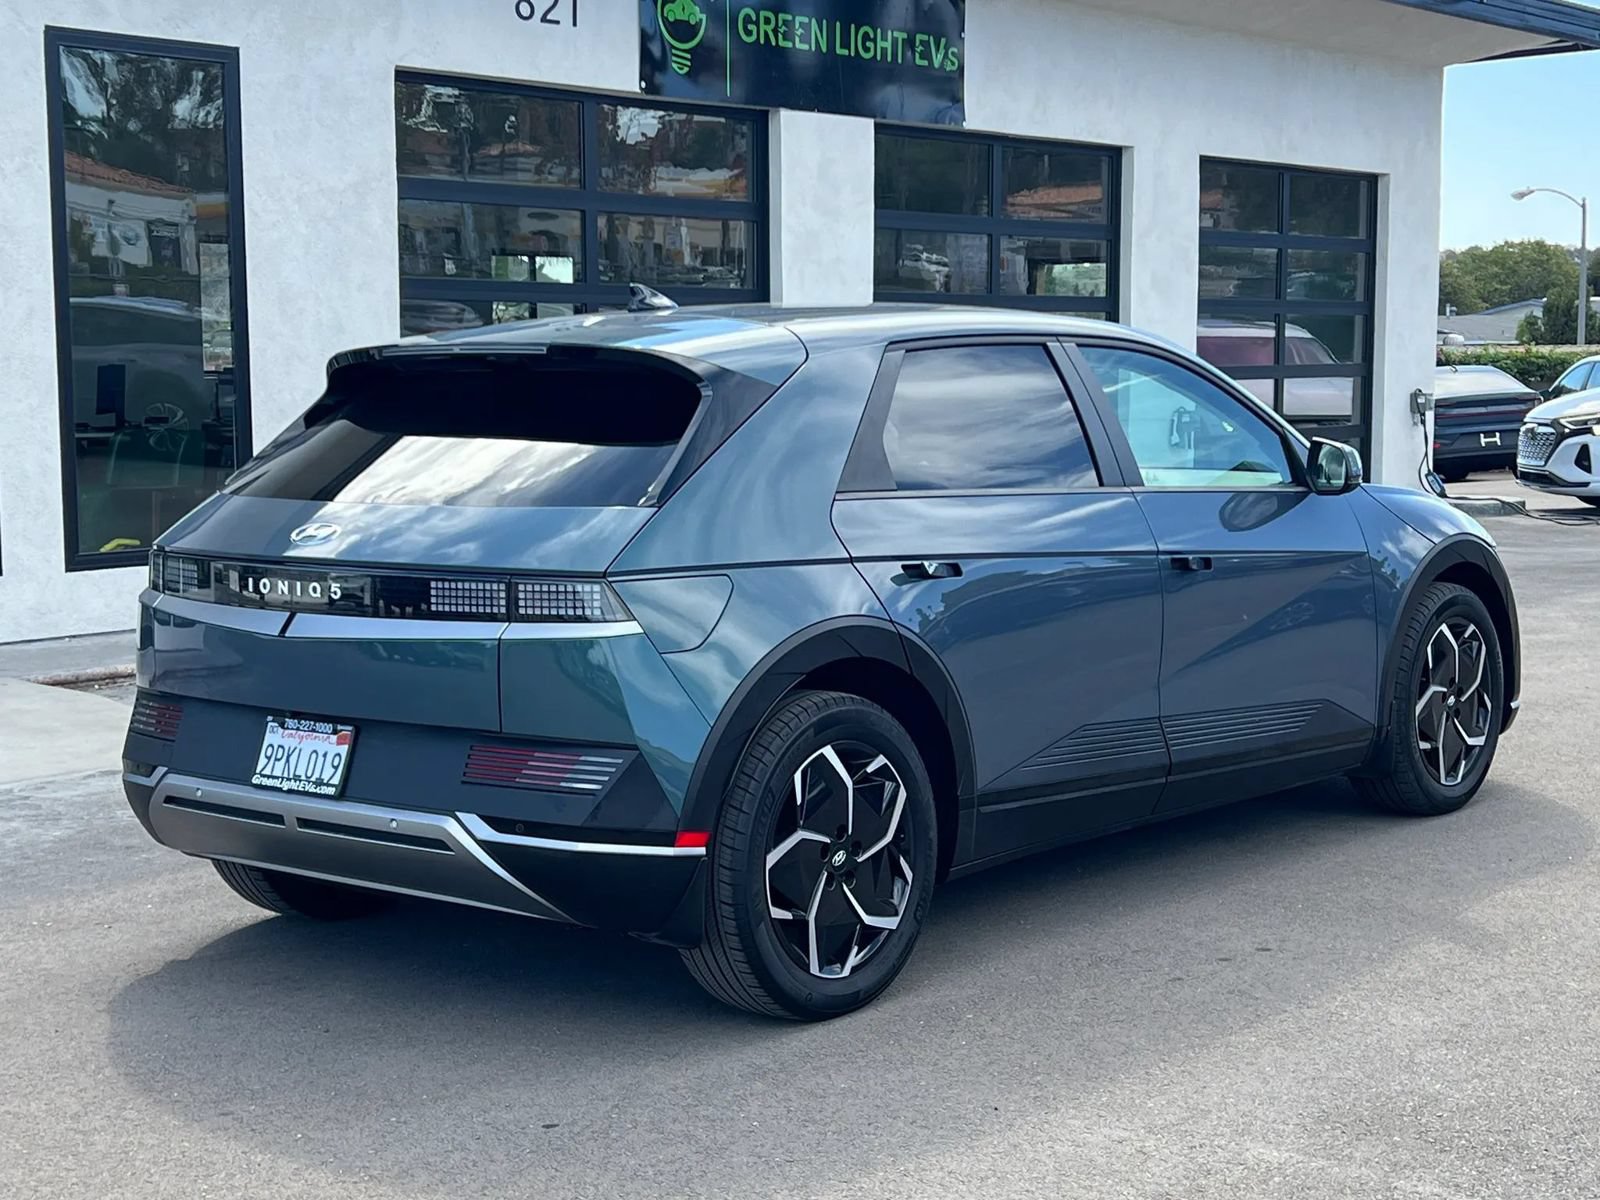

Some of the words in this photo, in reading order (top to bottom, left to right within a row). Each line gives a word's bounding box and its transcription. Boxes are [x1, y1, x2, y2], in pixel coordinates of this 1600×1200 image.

[737, 7, 827, 53] GREEN
[835, 20, 908, 65] LIGHT
[248, 577, 322, 598] IONIQ
[330, 583, 342, 600] 5
[285, 718, 333, 733] 760-227-1000
[260, 743, 342, 784] 9PKL019
[251, 774, 336, 796] GreenLightEVs.com
